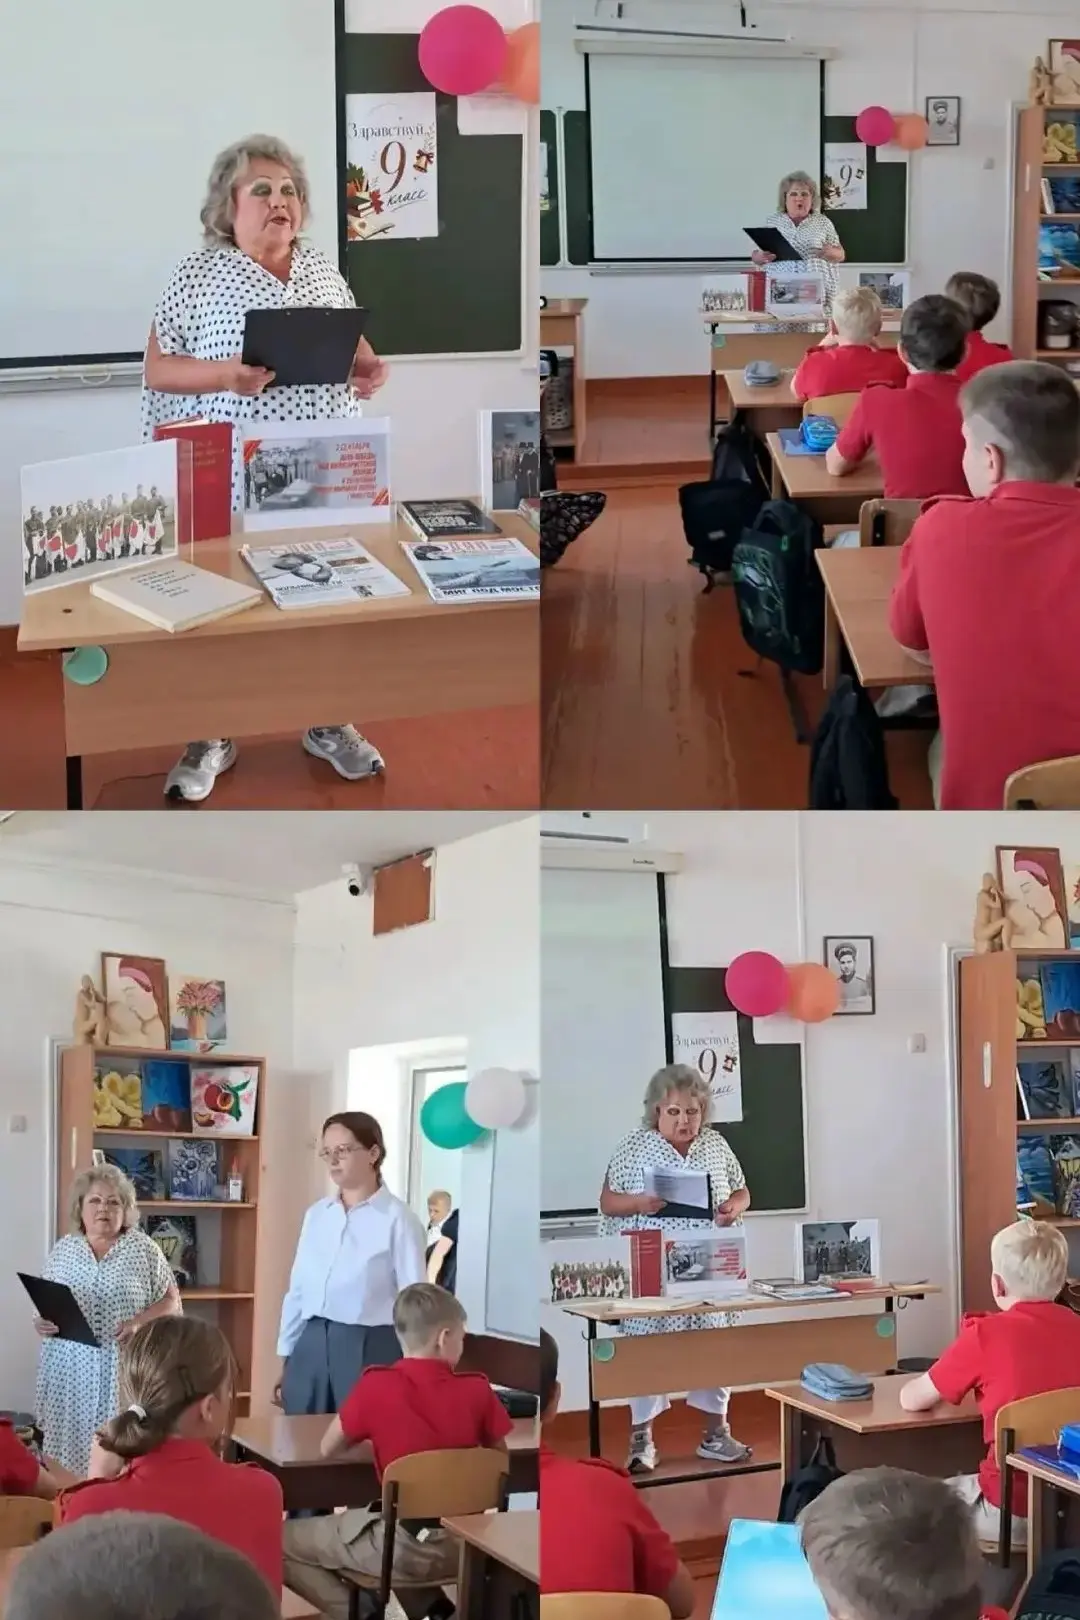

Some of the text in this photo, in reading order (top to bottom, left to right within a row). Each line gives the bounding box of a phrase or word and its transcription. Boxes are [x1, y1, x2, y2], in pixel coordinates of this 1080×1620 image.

[350, 122, 425, 141] Здравствуй
[380, 140, 407, 194] 9
[840, 164, 853, 188] 9
[387, 189, 429, 206] класс
[698, 1048, 718, 1084] 9
